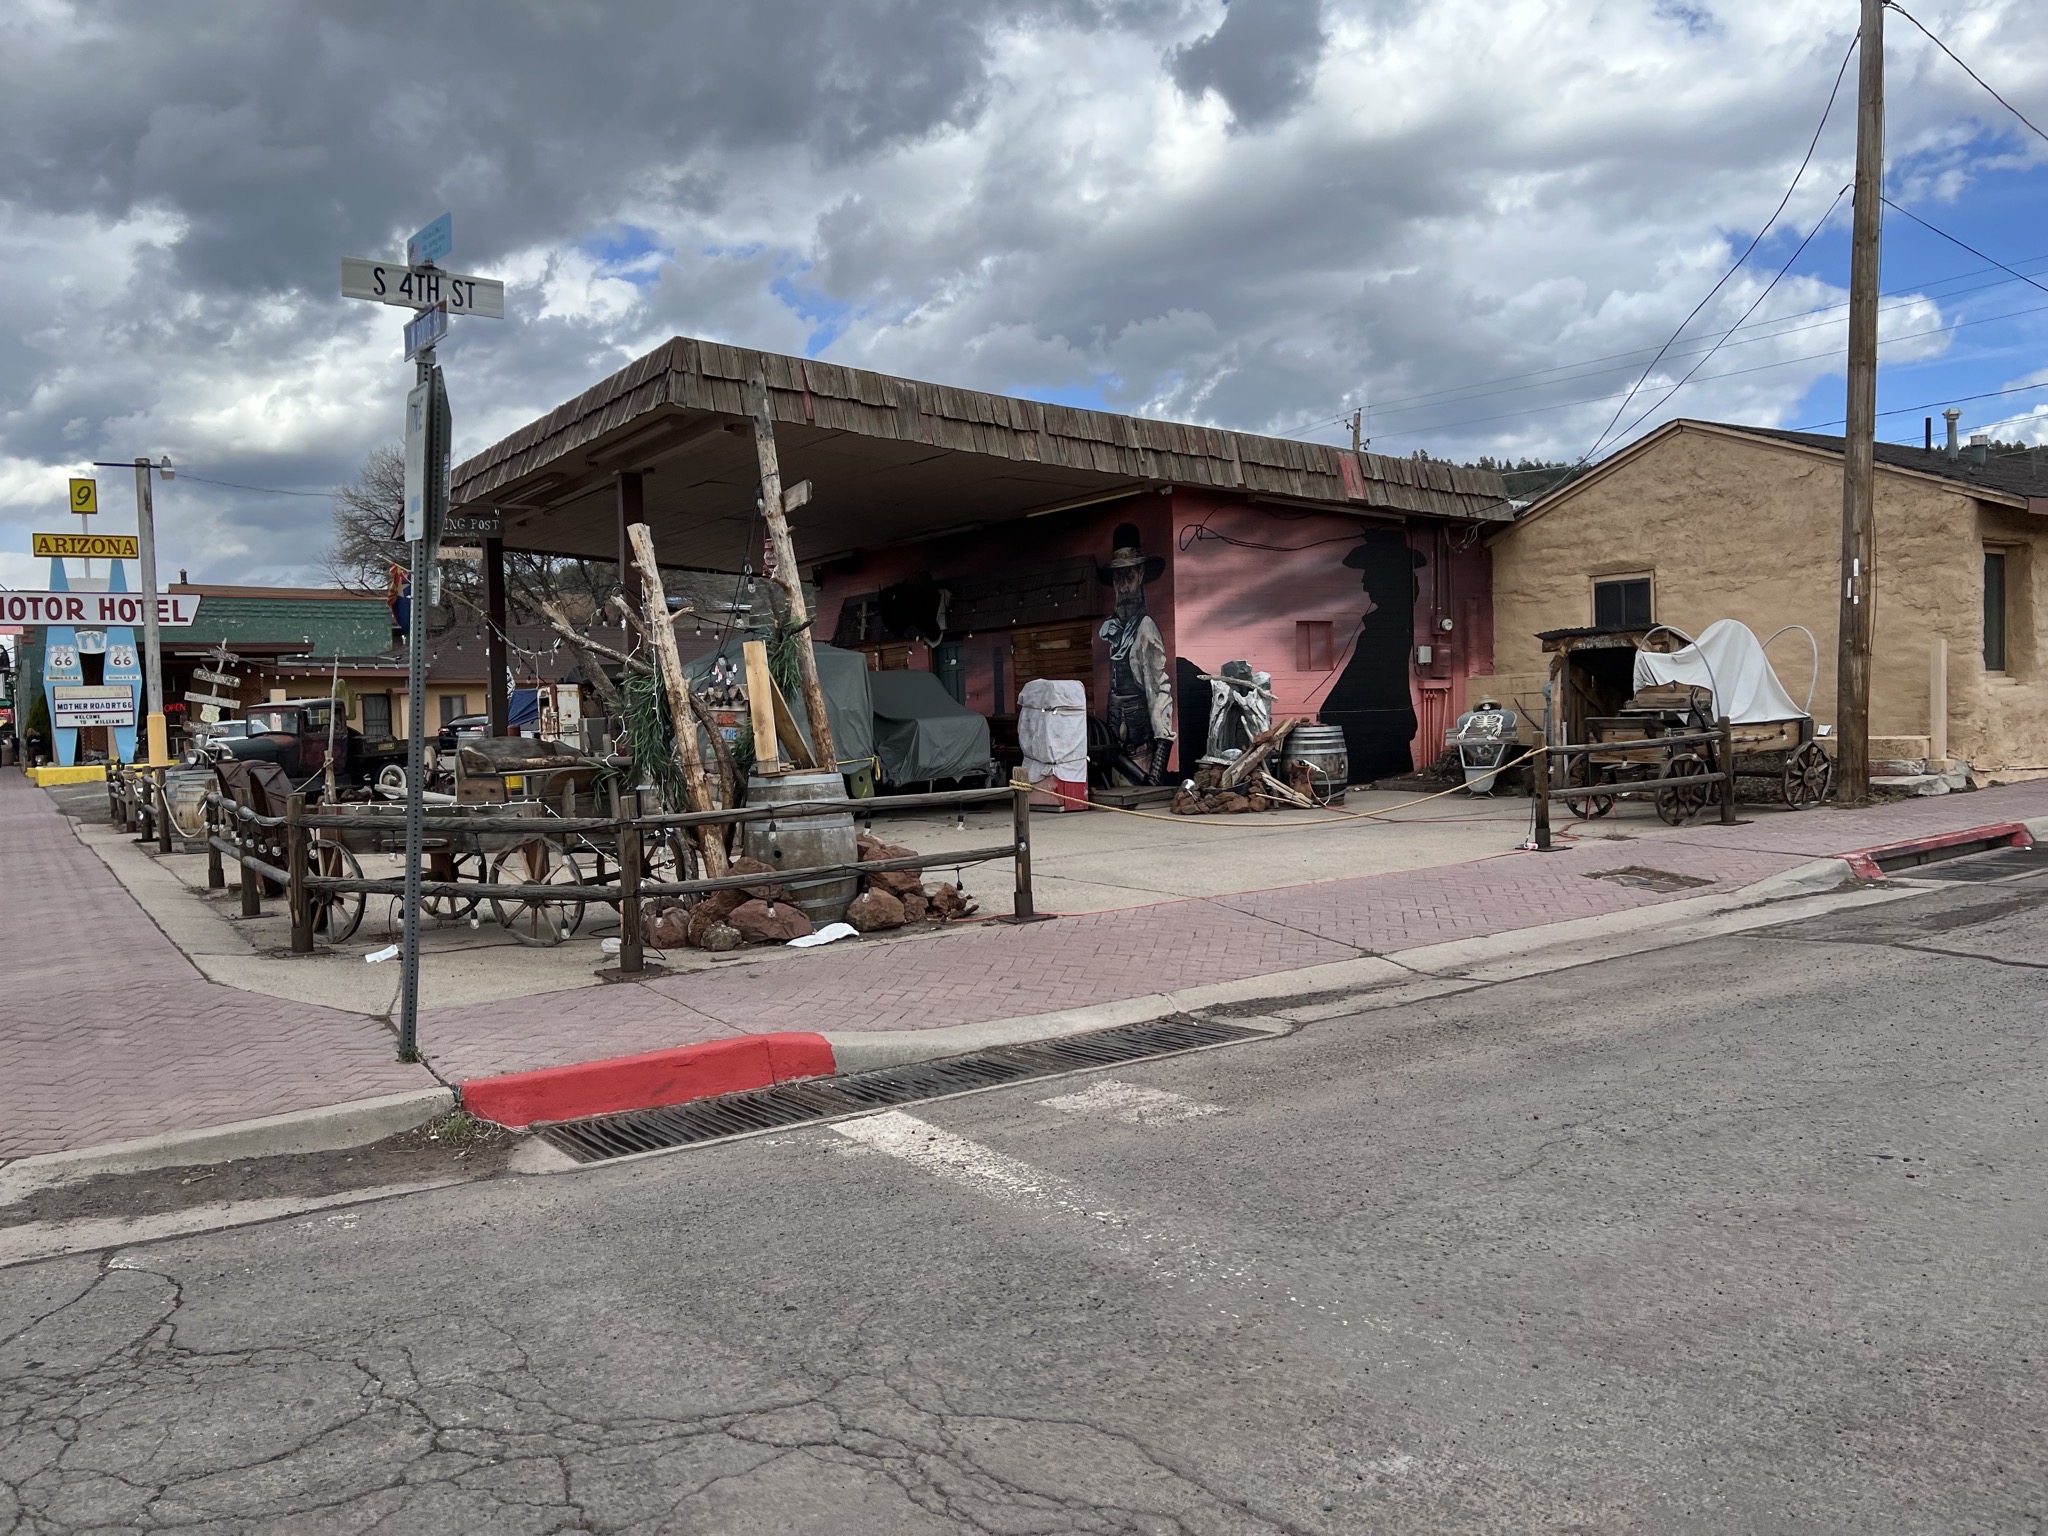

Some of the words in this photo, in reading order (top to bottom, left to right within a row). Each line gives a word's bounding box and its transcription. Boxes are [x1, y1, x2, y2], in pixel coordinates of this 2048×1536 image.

[373, 267, 386, 296] S
[400, 273, 439, 302] 4TH
[452, 279, 476, 308] ST
[76, 485, 91, 506] 9
[470, 518, 500, 530] POST
[36, 536, 137, 556] ARIZONA
[54, 656, 72, 666] 66
[113, 656, 131, 666] 66
[57, 702, 88, 710] MOTHER
[163, 703, 186, 713] OPEN
